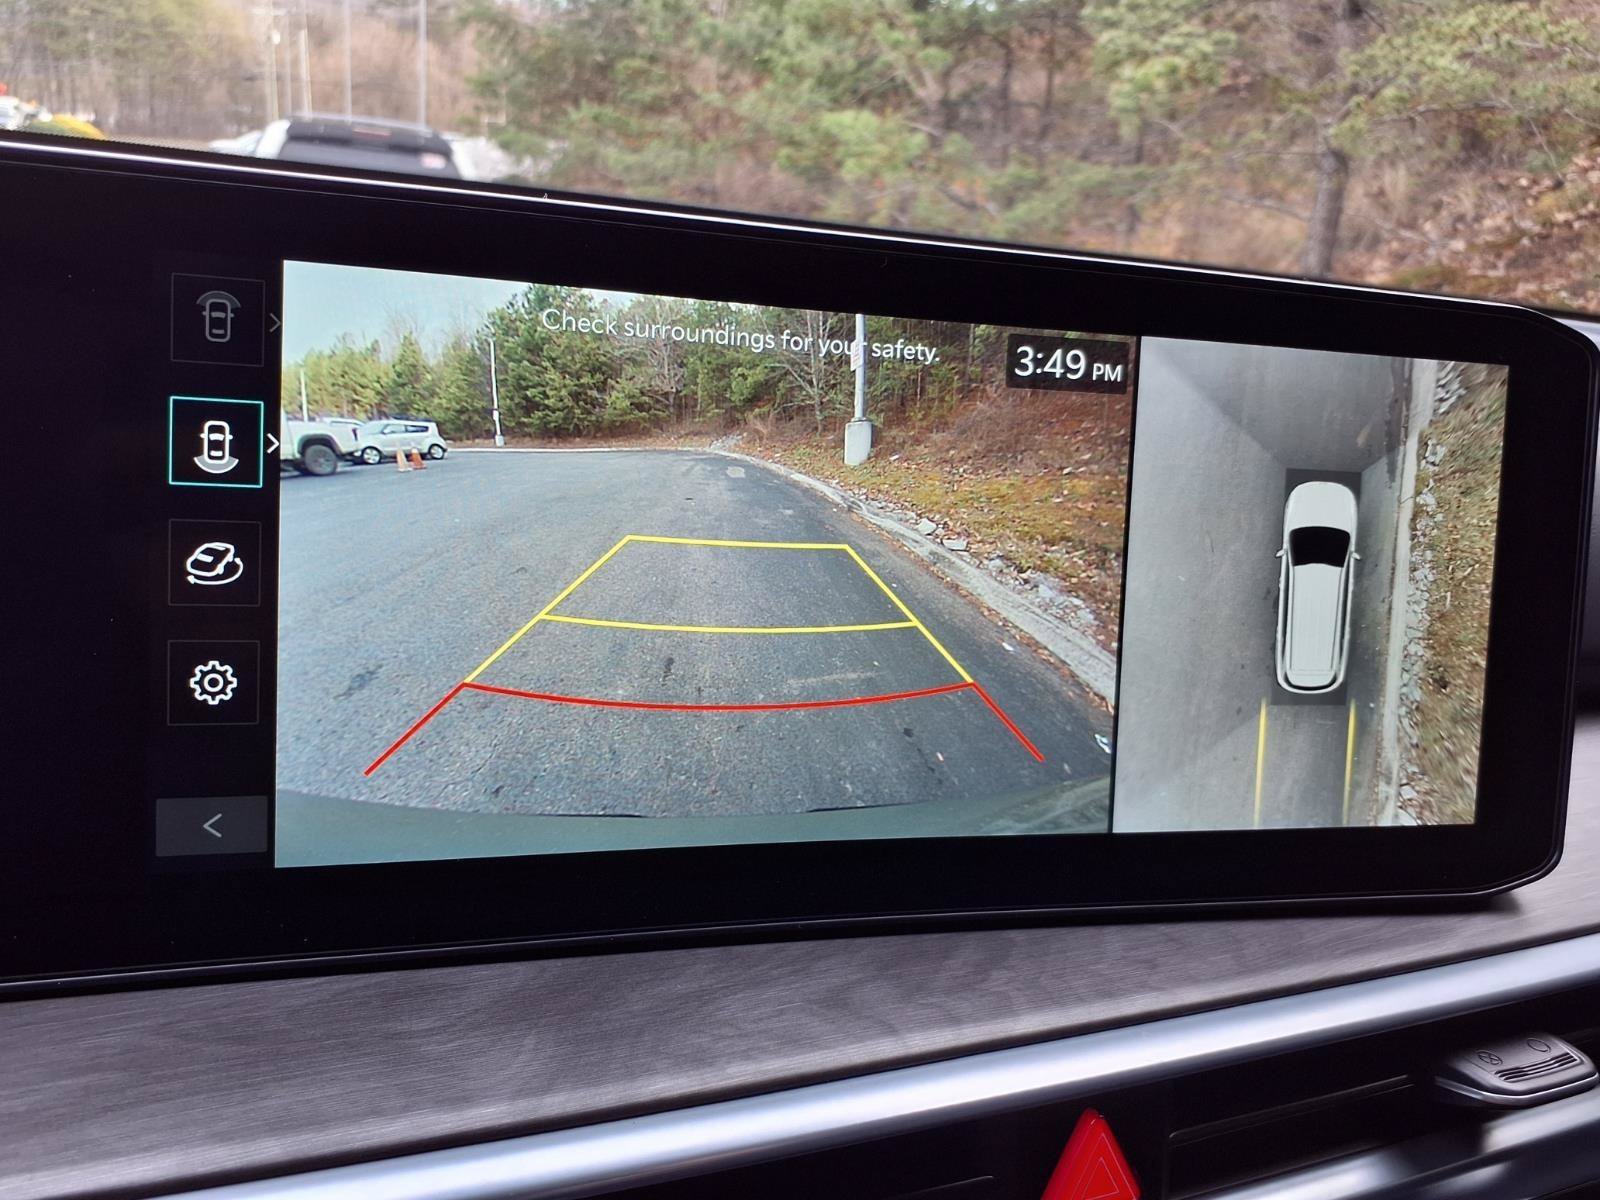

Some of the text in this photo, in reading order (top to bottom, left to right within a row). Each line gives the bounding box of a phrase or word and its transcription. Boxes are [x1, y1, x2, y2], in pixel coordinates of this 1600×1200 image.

[542, 308, 618, 336] Check
[623, 320, 776, 353] surroundings
[780, 329, 813, 352] for
[818, 337, 868, 357] your
[871, 338, 940, 365] safety.
[1014, 345, 1123, 383] 3:49 PM
